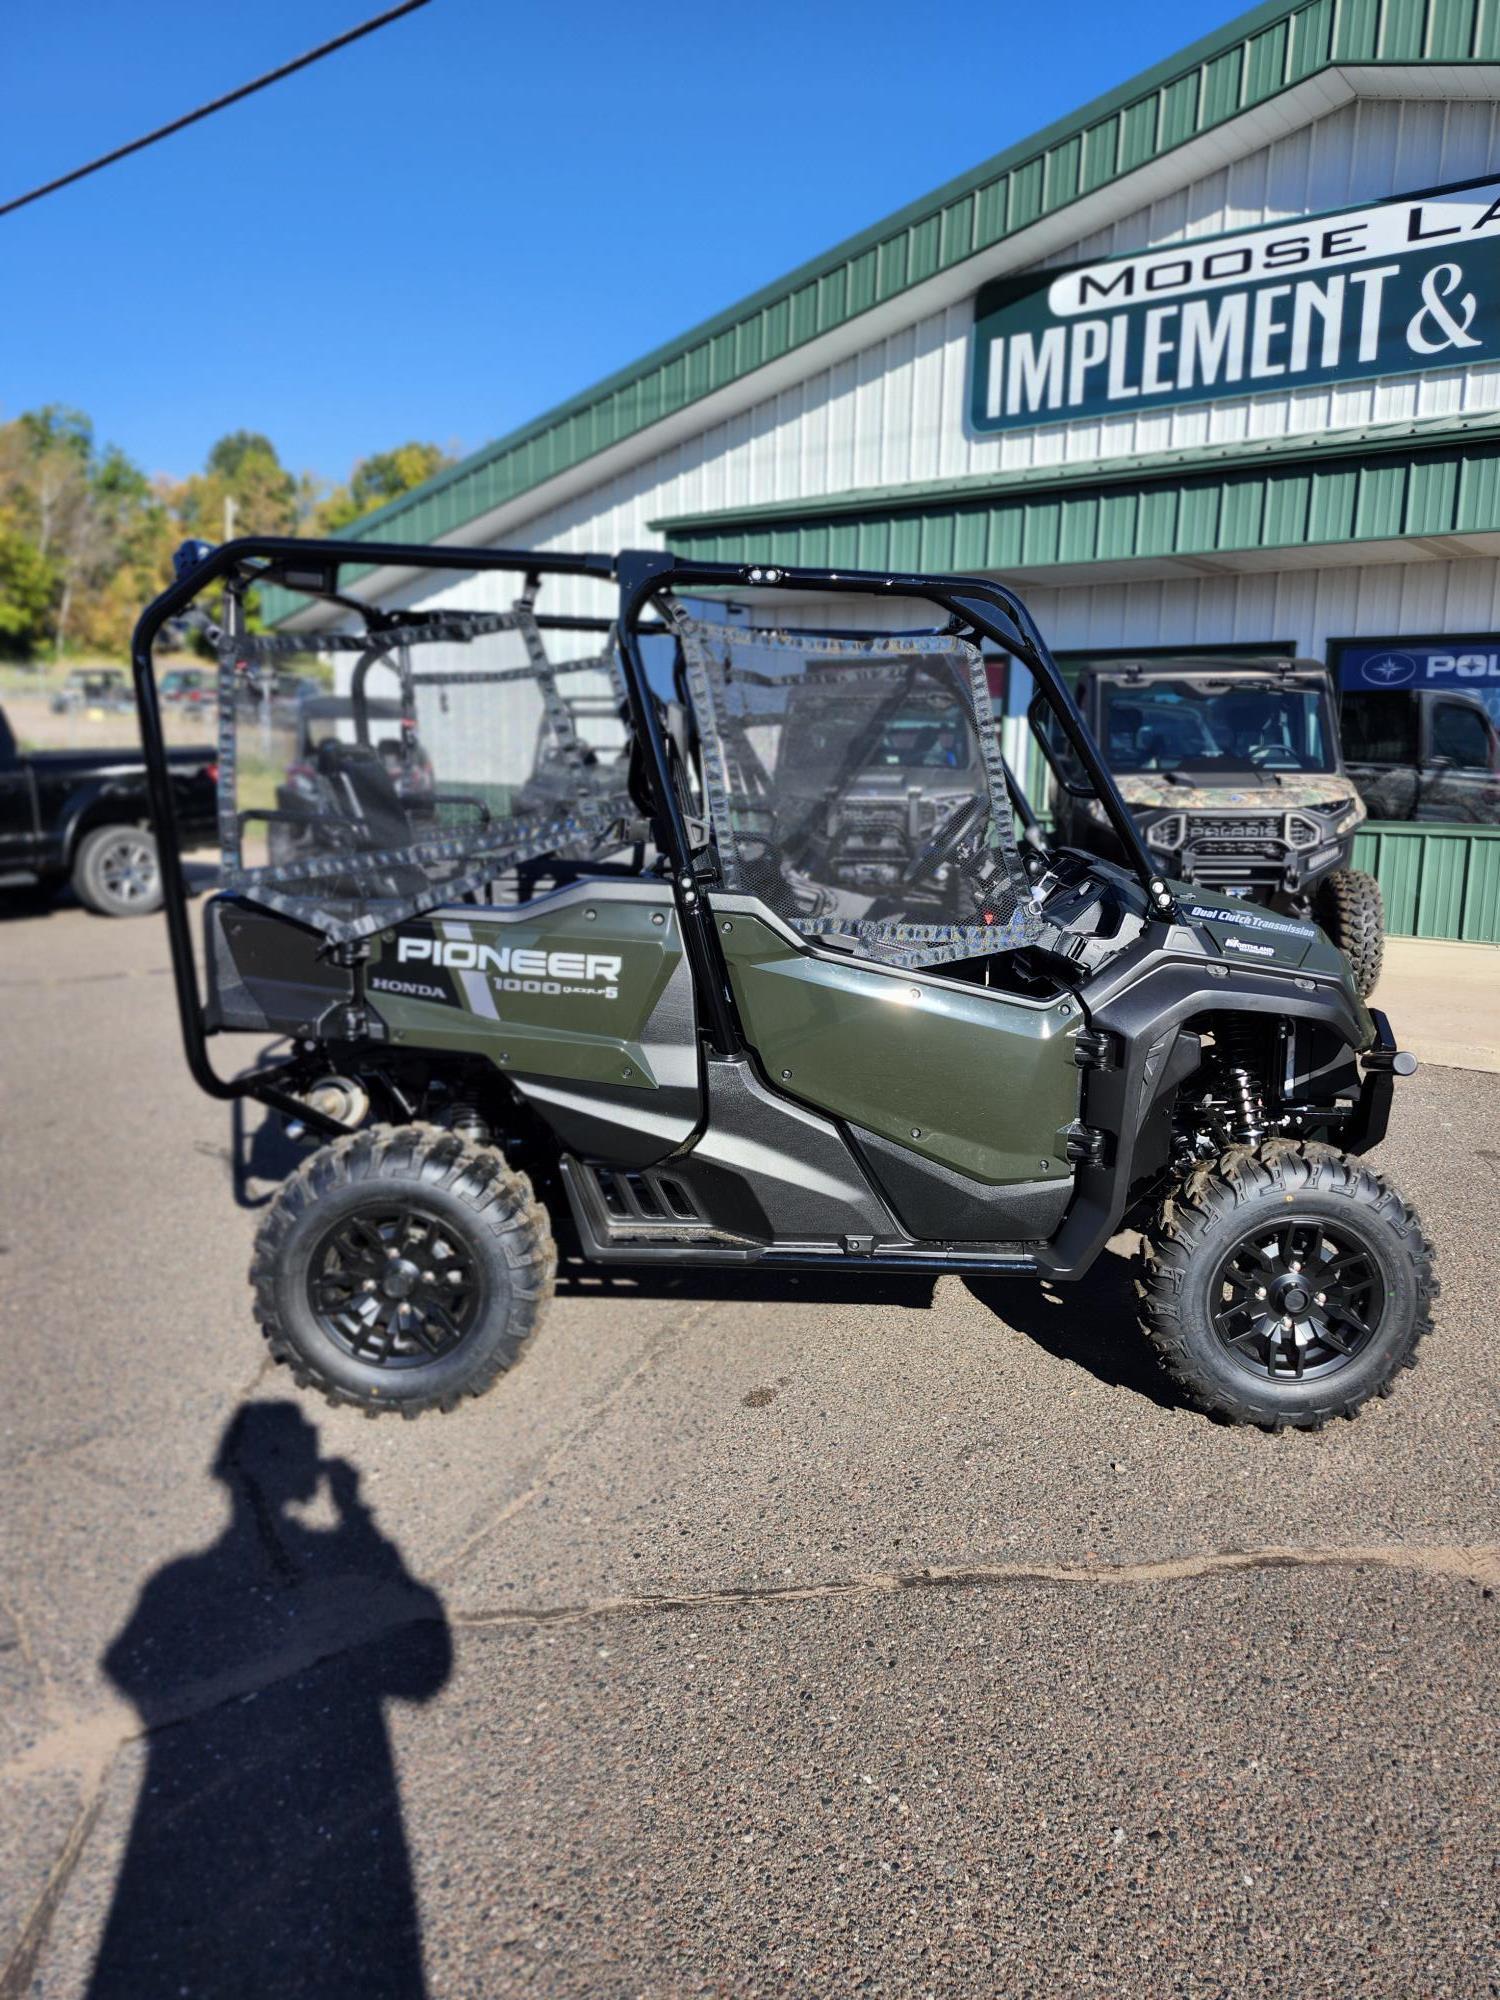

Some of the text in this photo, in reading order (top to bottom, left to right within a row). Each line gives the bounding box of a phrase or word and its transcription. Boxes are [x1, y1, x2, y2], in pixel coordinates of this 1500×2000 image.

[1078, 223, 1368, 306] MOOSE
[986, 262, 1482, 419] IMPLEMENT &
[1190, 826, 1279, 837] POLARIS
[1191, 906, 1315, 937] Dual Clutch Transmission
[397, 937, 622, 981] PIONEER
[371, 977, 447, 999] HONDA
[494, 977, 561, 995] 1000
